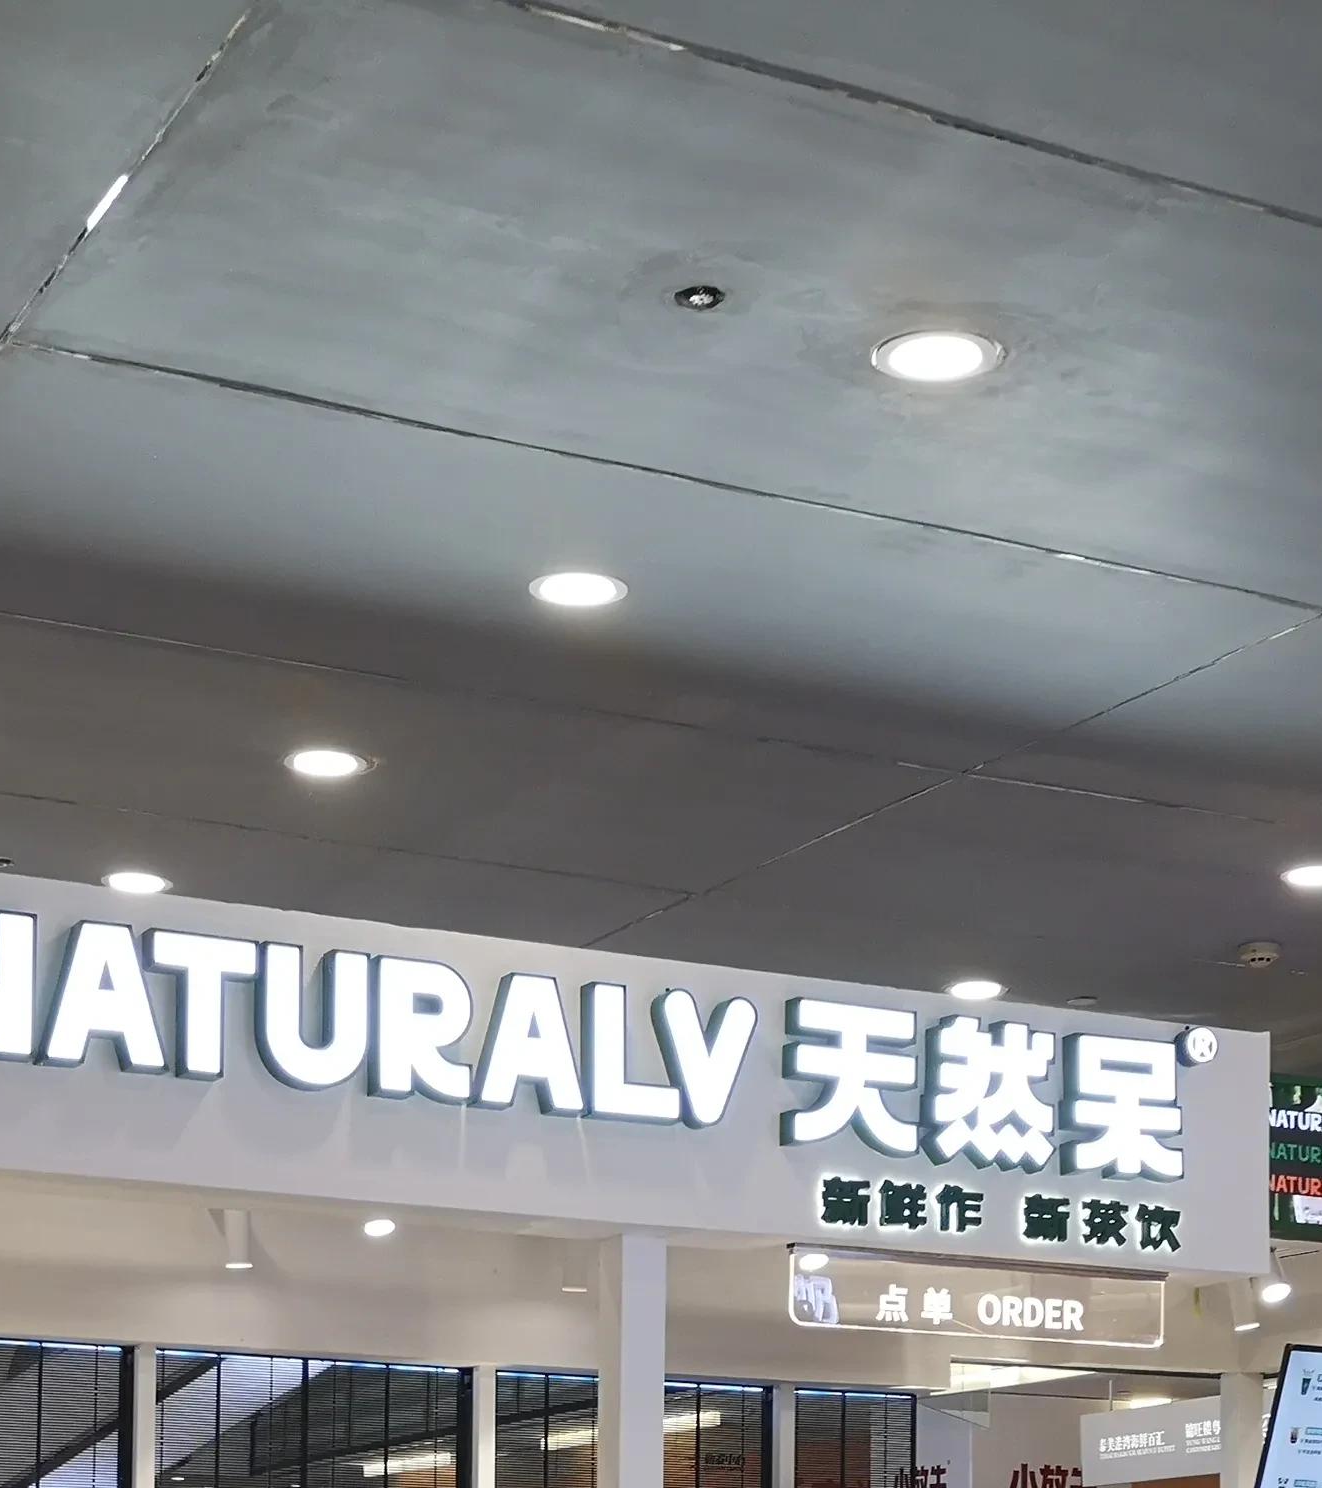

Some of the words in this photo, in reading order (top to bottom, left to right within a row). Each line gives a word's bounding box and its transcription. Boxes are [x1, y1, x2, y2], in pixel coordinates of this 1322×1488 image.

[781, 995, 1185, 1180] 天然呆
[820, 1175, 984, 1233] 新鲜作
[1022, 1193, 1182, 1253] 新茶饮
[876, 1284, 954, 1325] 点单
[977, 1293, 1084, 1331] ORDER
